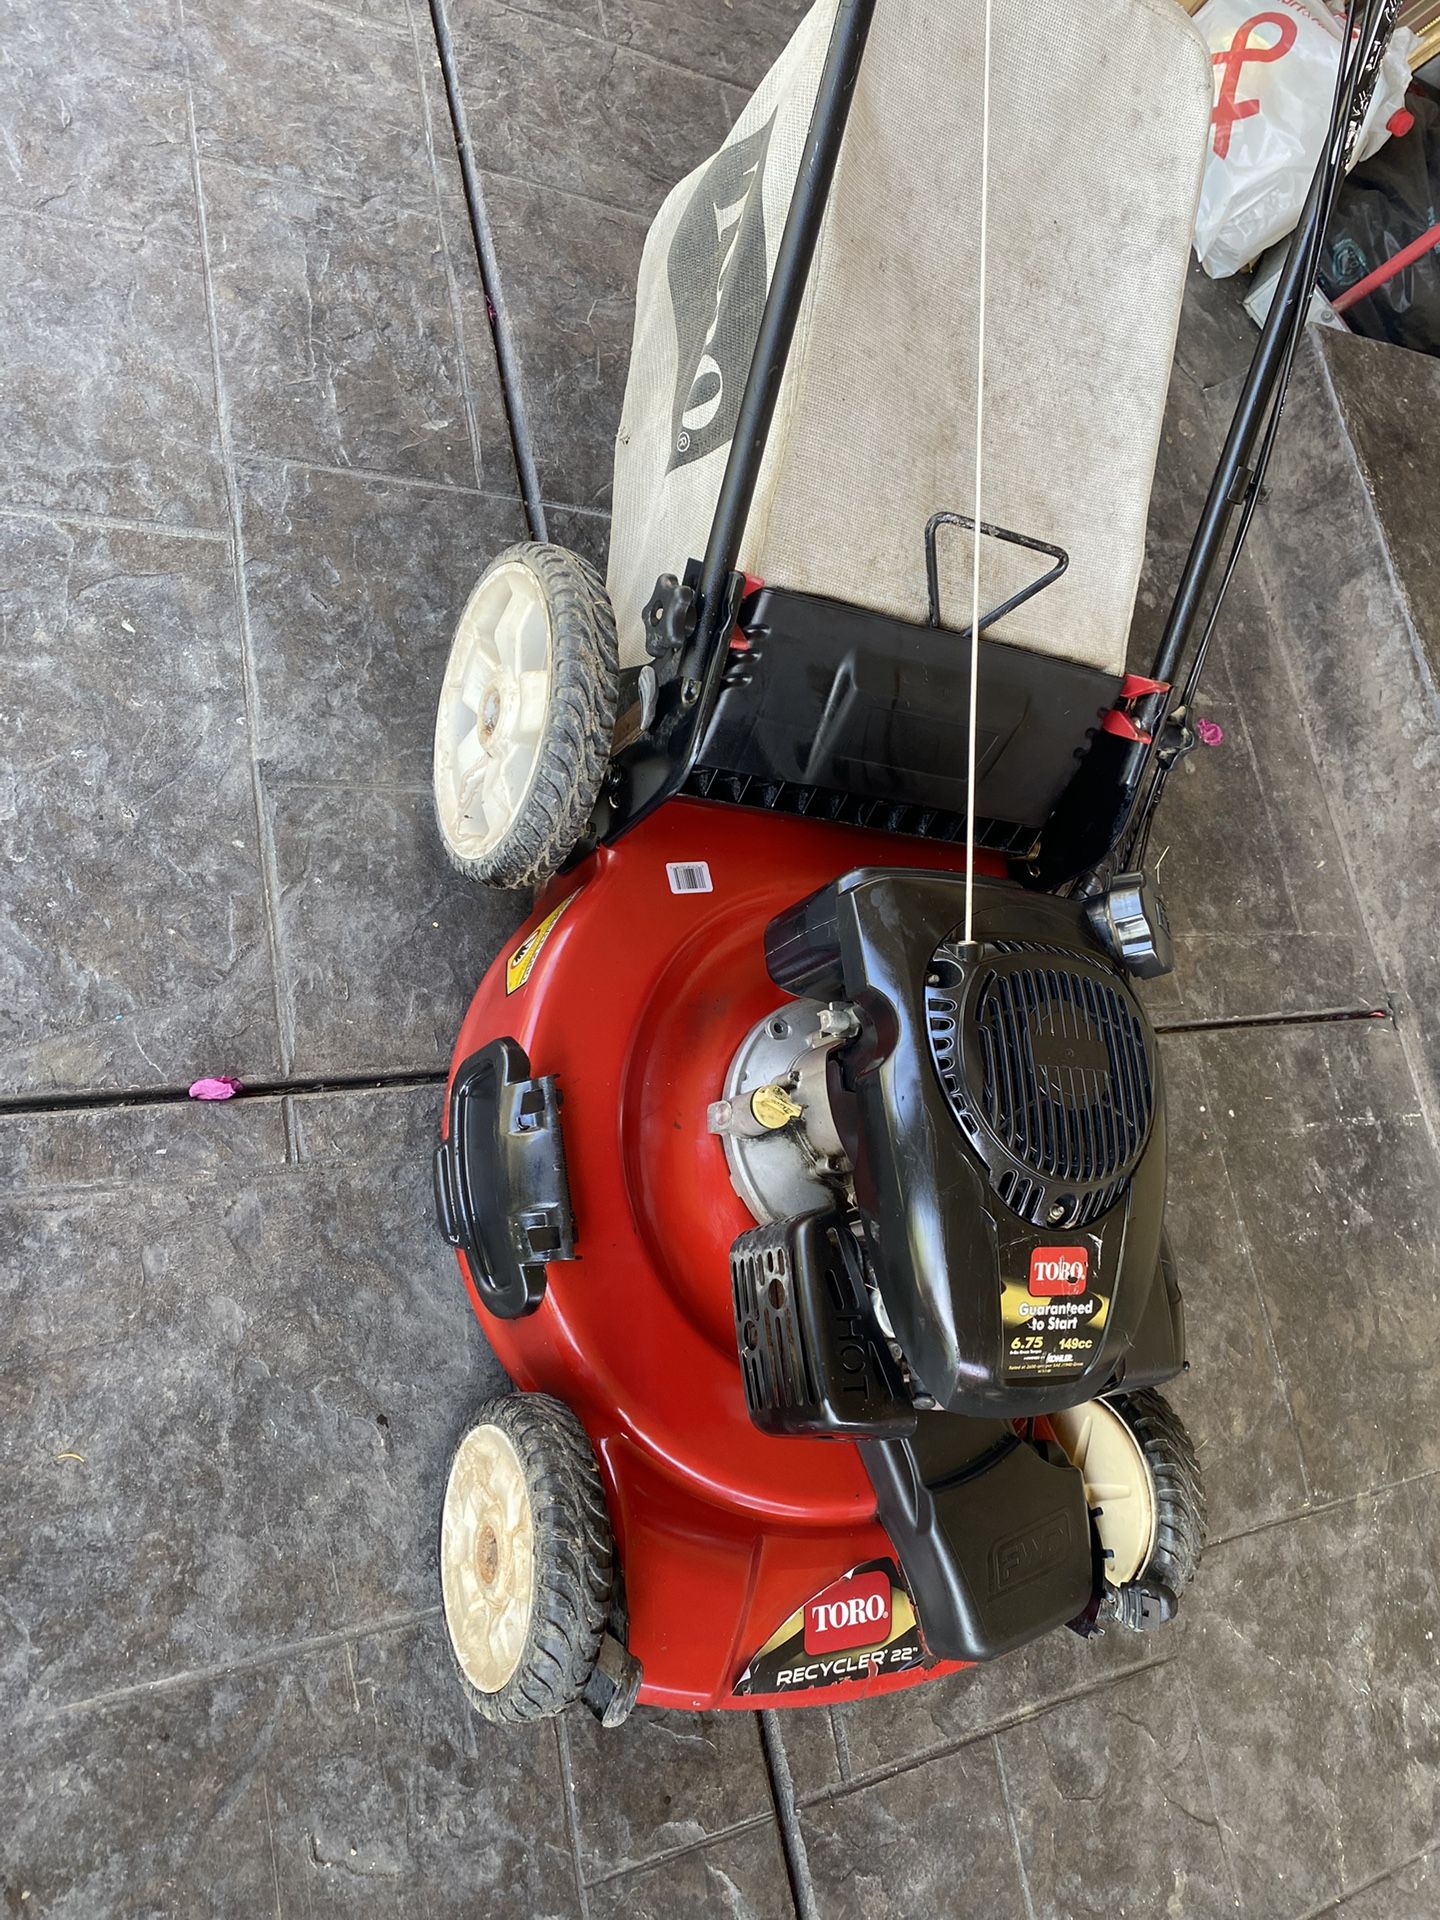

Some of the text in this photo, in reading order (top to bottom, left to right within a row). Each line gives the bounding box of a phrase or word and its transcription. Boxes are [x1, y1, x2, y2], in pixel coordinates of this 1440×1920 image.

[1034, 1261, 1084, 1281] TORO
[1018, 1300, 1094, 1316] Guaranteed
[1031, 1316, 1078, 1331] to Start
[1010, 1336, 1093, 1350] 6.75 149cc
[836, 1314, 870, 1401] HOT
[811, 1594, 886, 1633] TORO
[776, 1647, 919, 1686] RECYCLER 22"
